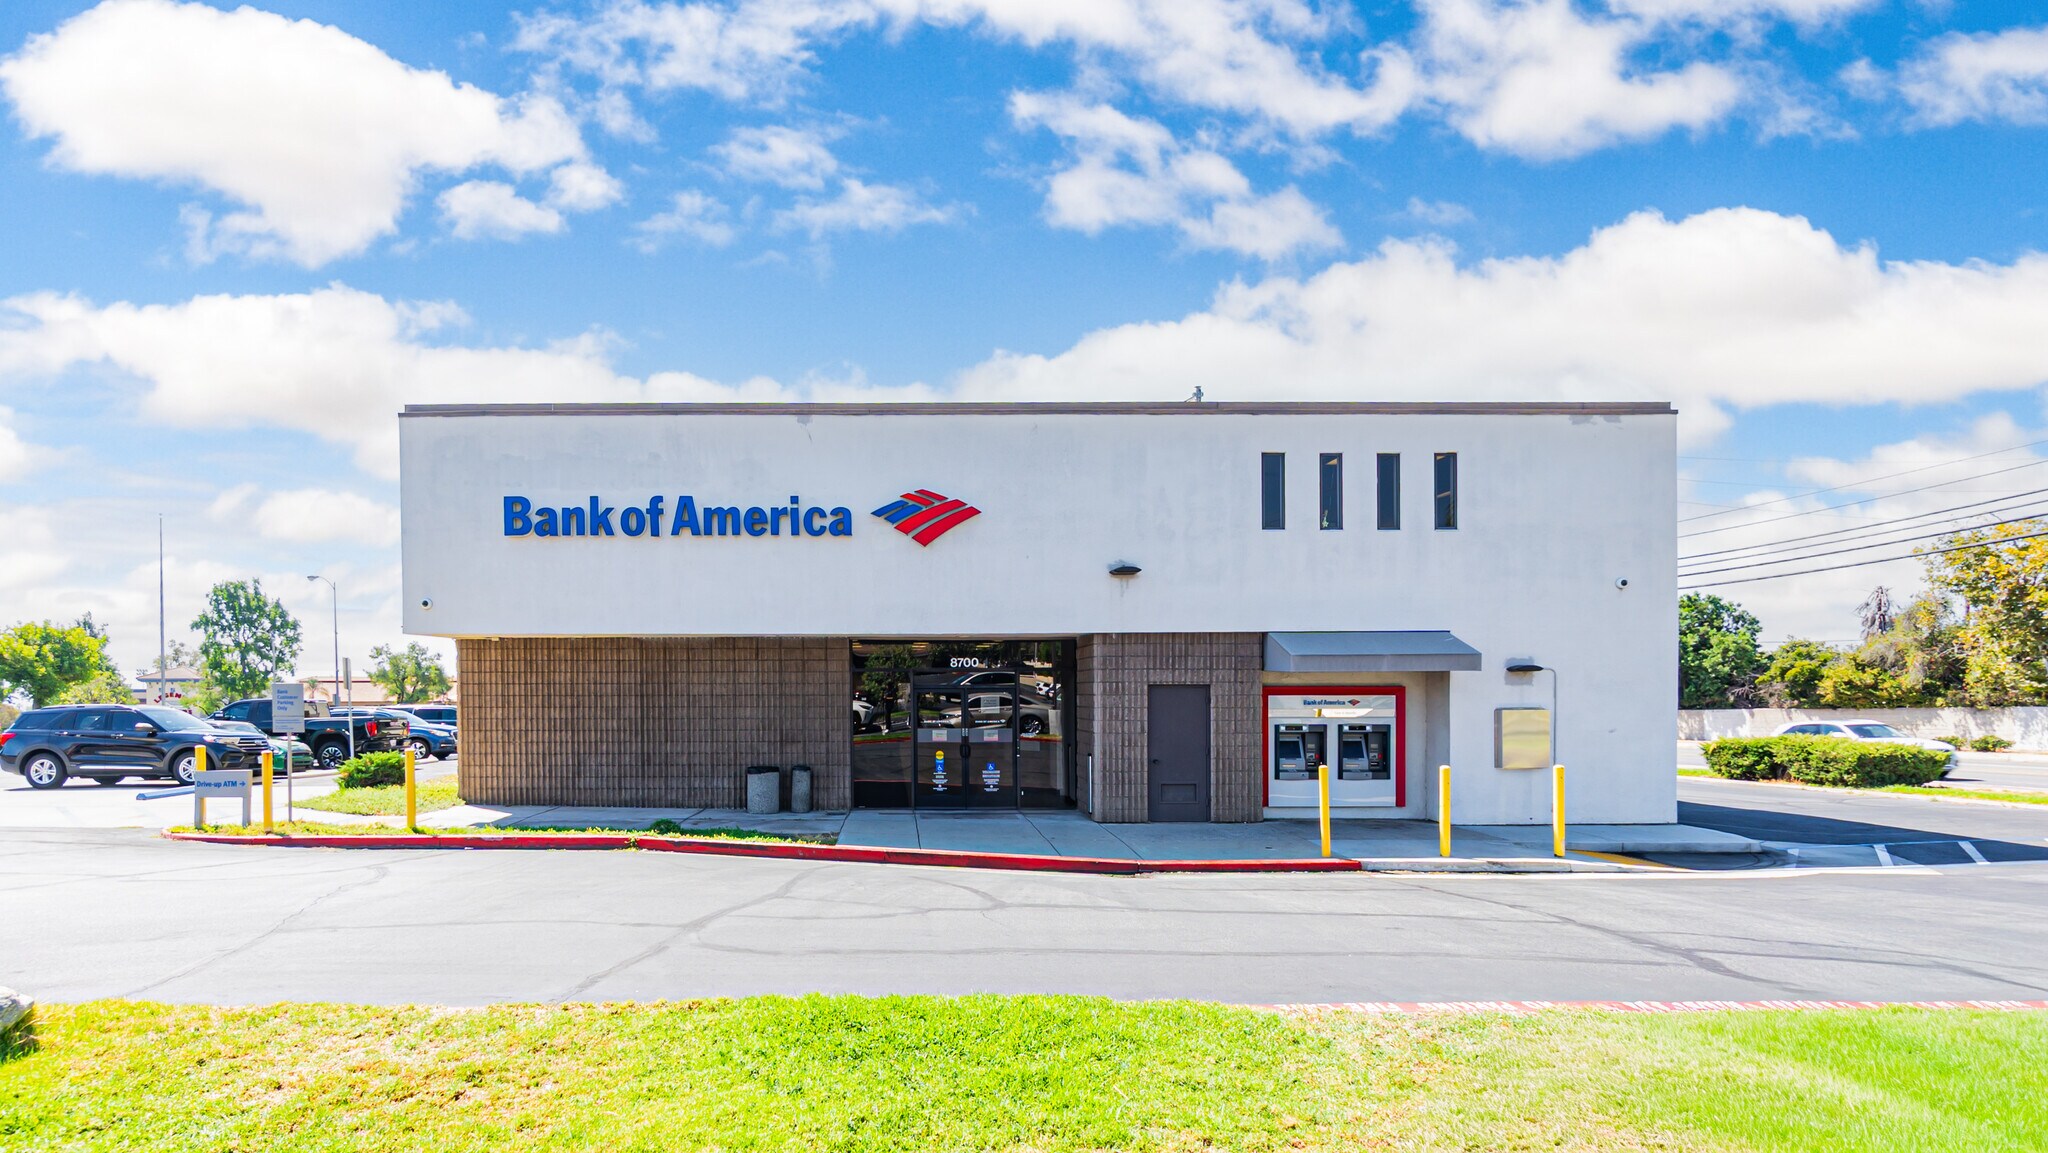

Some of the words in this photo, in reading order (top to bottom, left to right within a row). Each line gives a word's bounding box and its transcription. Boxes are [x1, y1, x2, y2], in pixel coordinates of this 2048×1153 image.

[503, 495, 614, 537] Bank
[620, 495, 664, 537] of
[671, 495, 853, 537] America
[950, 657, 979, 668] 8700
